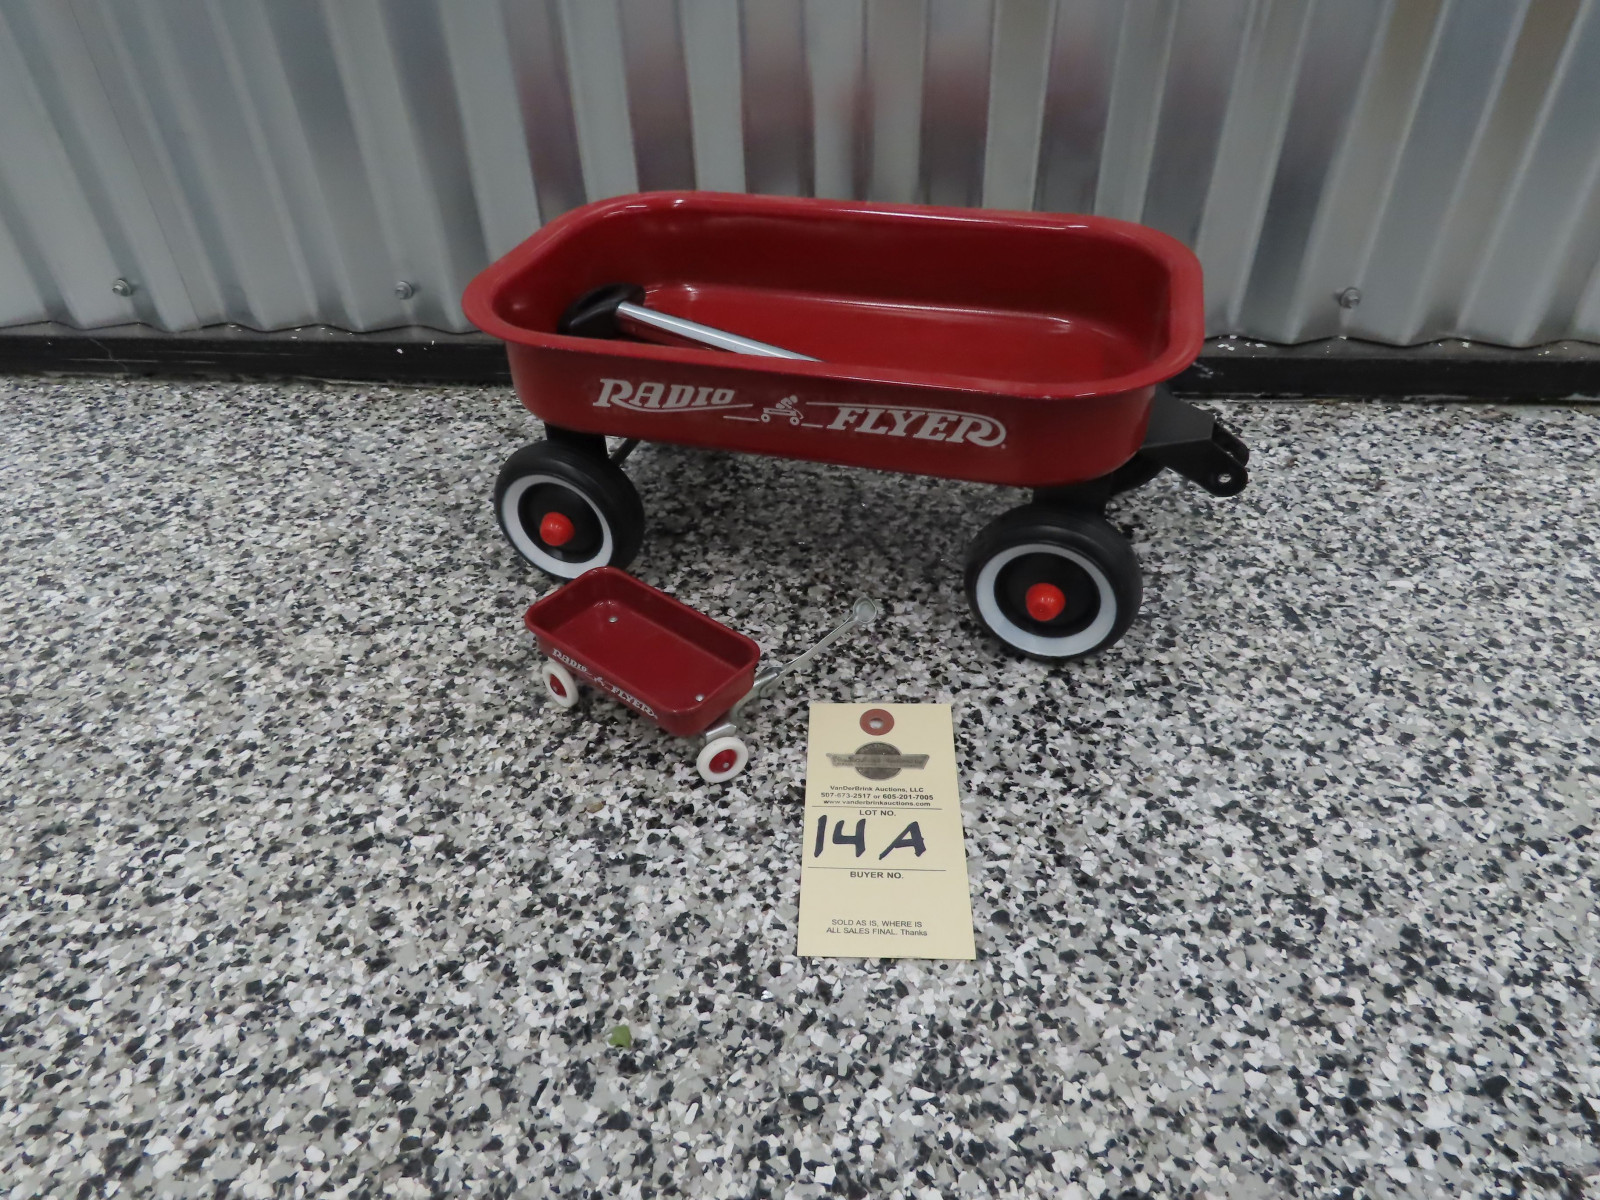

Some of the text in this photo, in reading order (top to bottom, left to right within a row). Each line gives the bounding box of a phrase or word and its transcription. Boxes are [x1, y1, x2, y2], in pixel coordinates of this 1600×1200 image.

[593, 379, 1007, 447] RADIO FLYER
[551, 648, 658, 719] RADIO FLYER
[880, 809, 897, 817] NO.
[813, 814, 926, 861] 14 A
[843, 927, 870, 935] SALES
[872, 928, 898, 936] FINAL.
[900, 928, 928, 936] Thanks
[869, 920, 879, 928] IS,
[881, 920, 912, 928] WHERE
